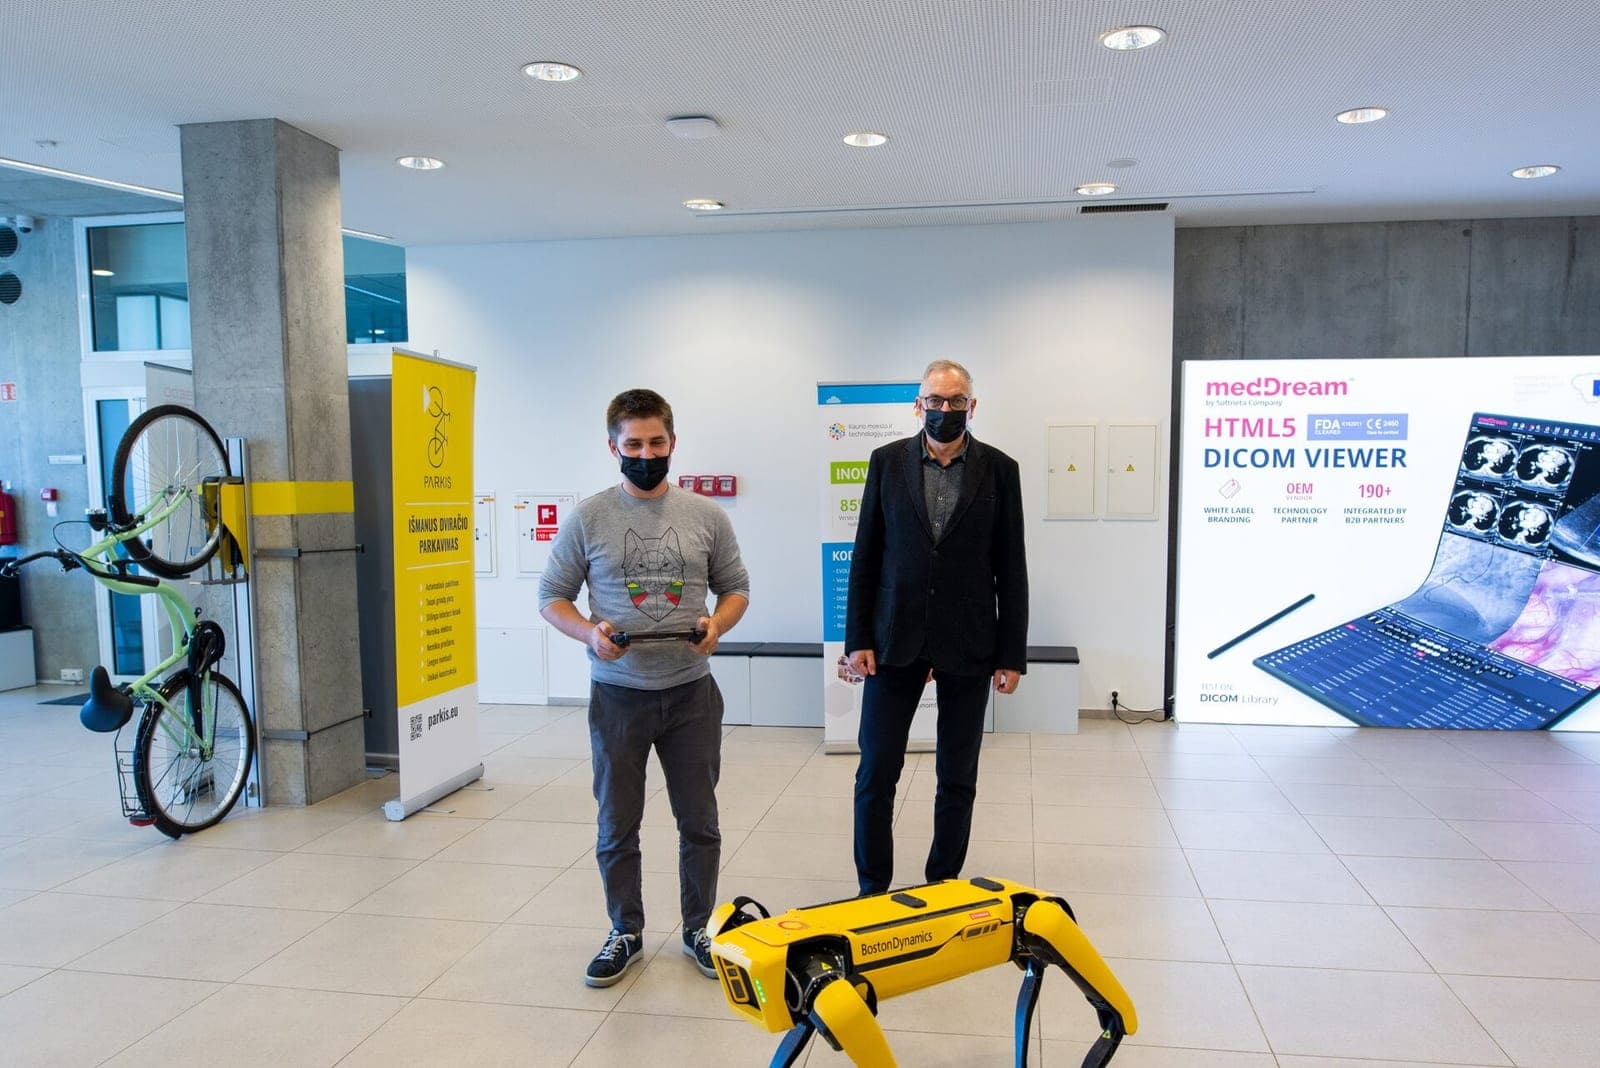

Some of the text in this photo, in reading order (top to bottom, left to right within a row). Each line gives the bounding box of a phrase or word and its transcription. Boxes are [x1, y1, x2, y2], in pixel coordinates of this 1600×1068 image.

[1206, 377, 1347, 396] medDream
[1205, 418, 1296, 438] HTML5
[1314, 419, 1341, 430] FDA
[1203, 448, 1407, 468] DICOM VIEWER
[424, 475, 452, 488] PARKIS
[1286, 482, 1313, 495] OEM
[1358, 483, 1392, 498] 190+
[1343, 507, 1394, 515] INTEGRATED
[409, 513, 468, 533] IŠMANUS DVIRAČIO
[420, 537, 459, 554] PARKAVIMAS
[1200, 694, 1279, 707] DICOM Library
[428, 706, 459, 730] parkis.eu
[861, 930, 933, 956] BostonDynamics
